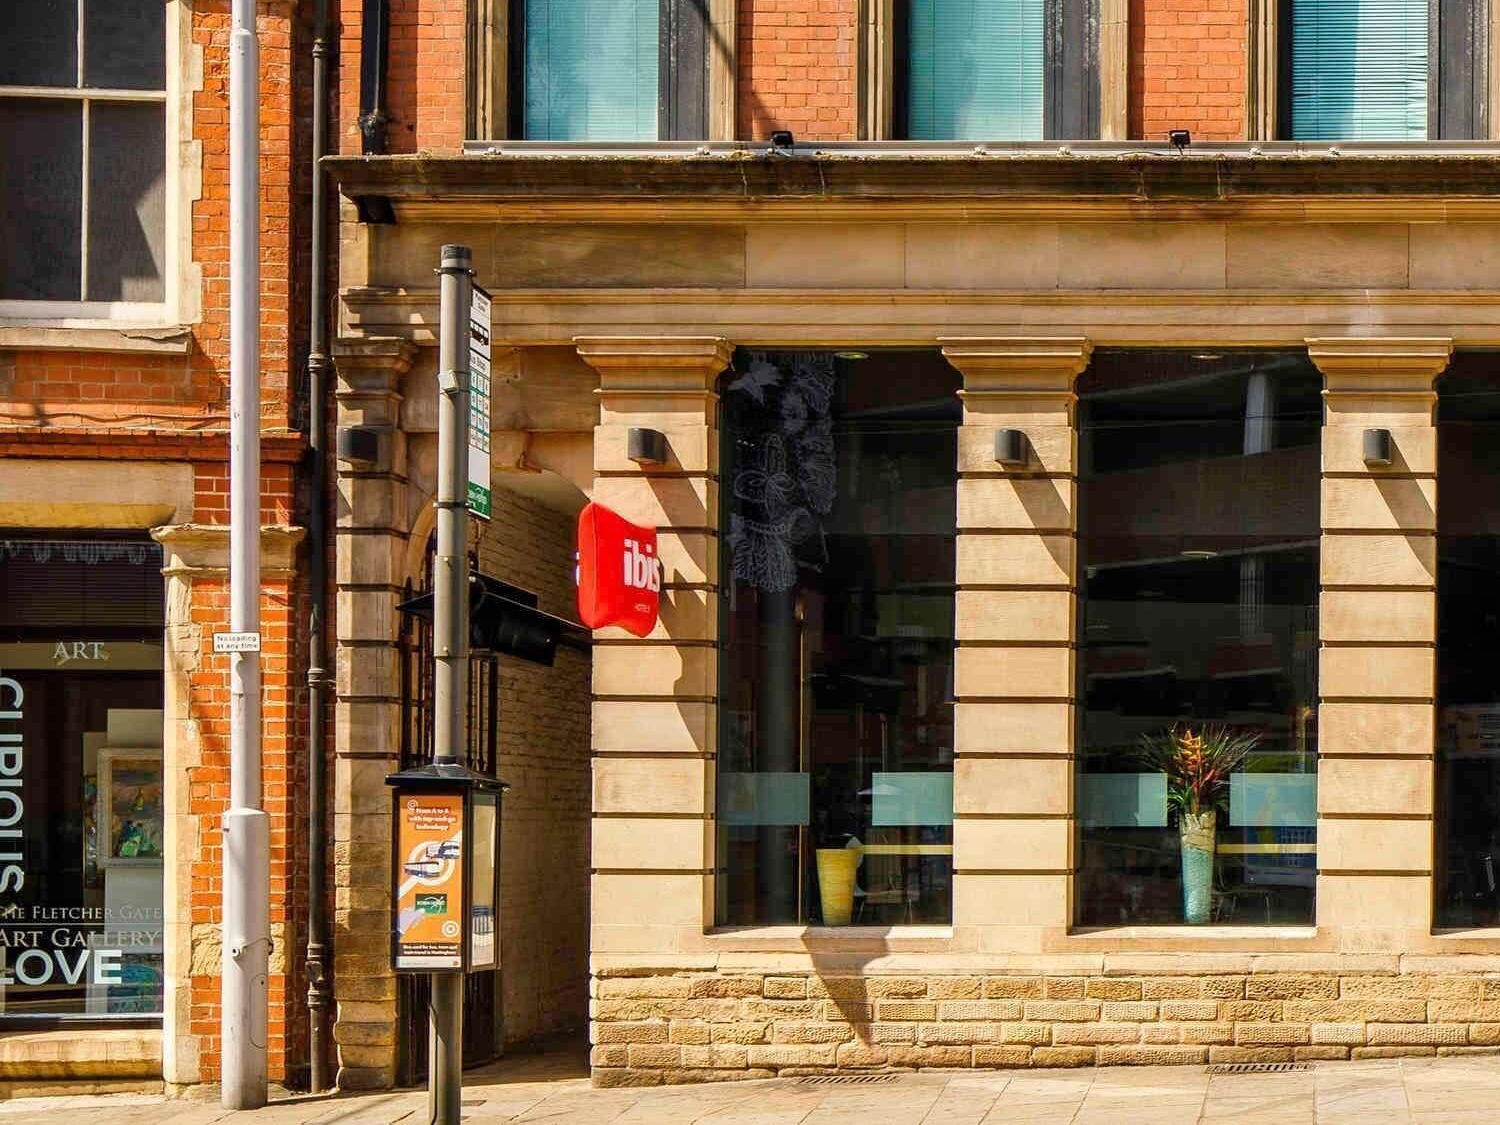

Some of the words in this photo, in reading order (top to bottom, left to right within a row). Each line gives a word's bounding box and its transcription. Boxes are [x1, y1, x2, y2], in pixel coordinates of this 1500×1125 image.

[624, 538, 660, 592] ibis
[53, 641, 105, 660] ART
[33, 906, 112, 919] FLETCHER
[120, 905, 161, 920] GATE
[51, 928, 159, 947] GALLERY
